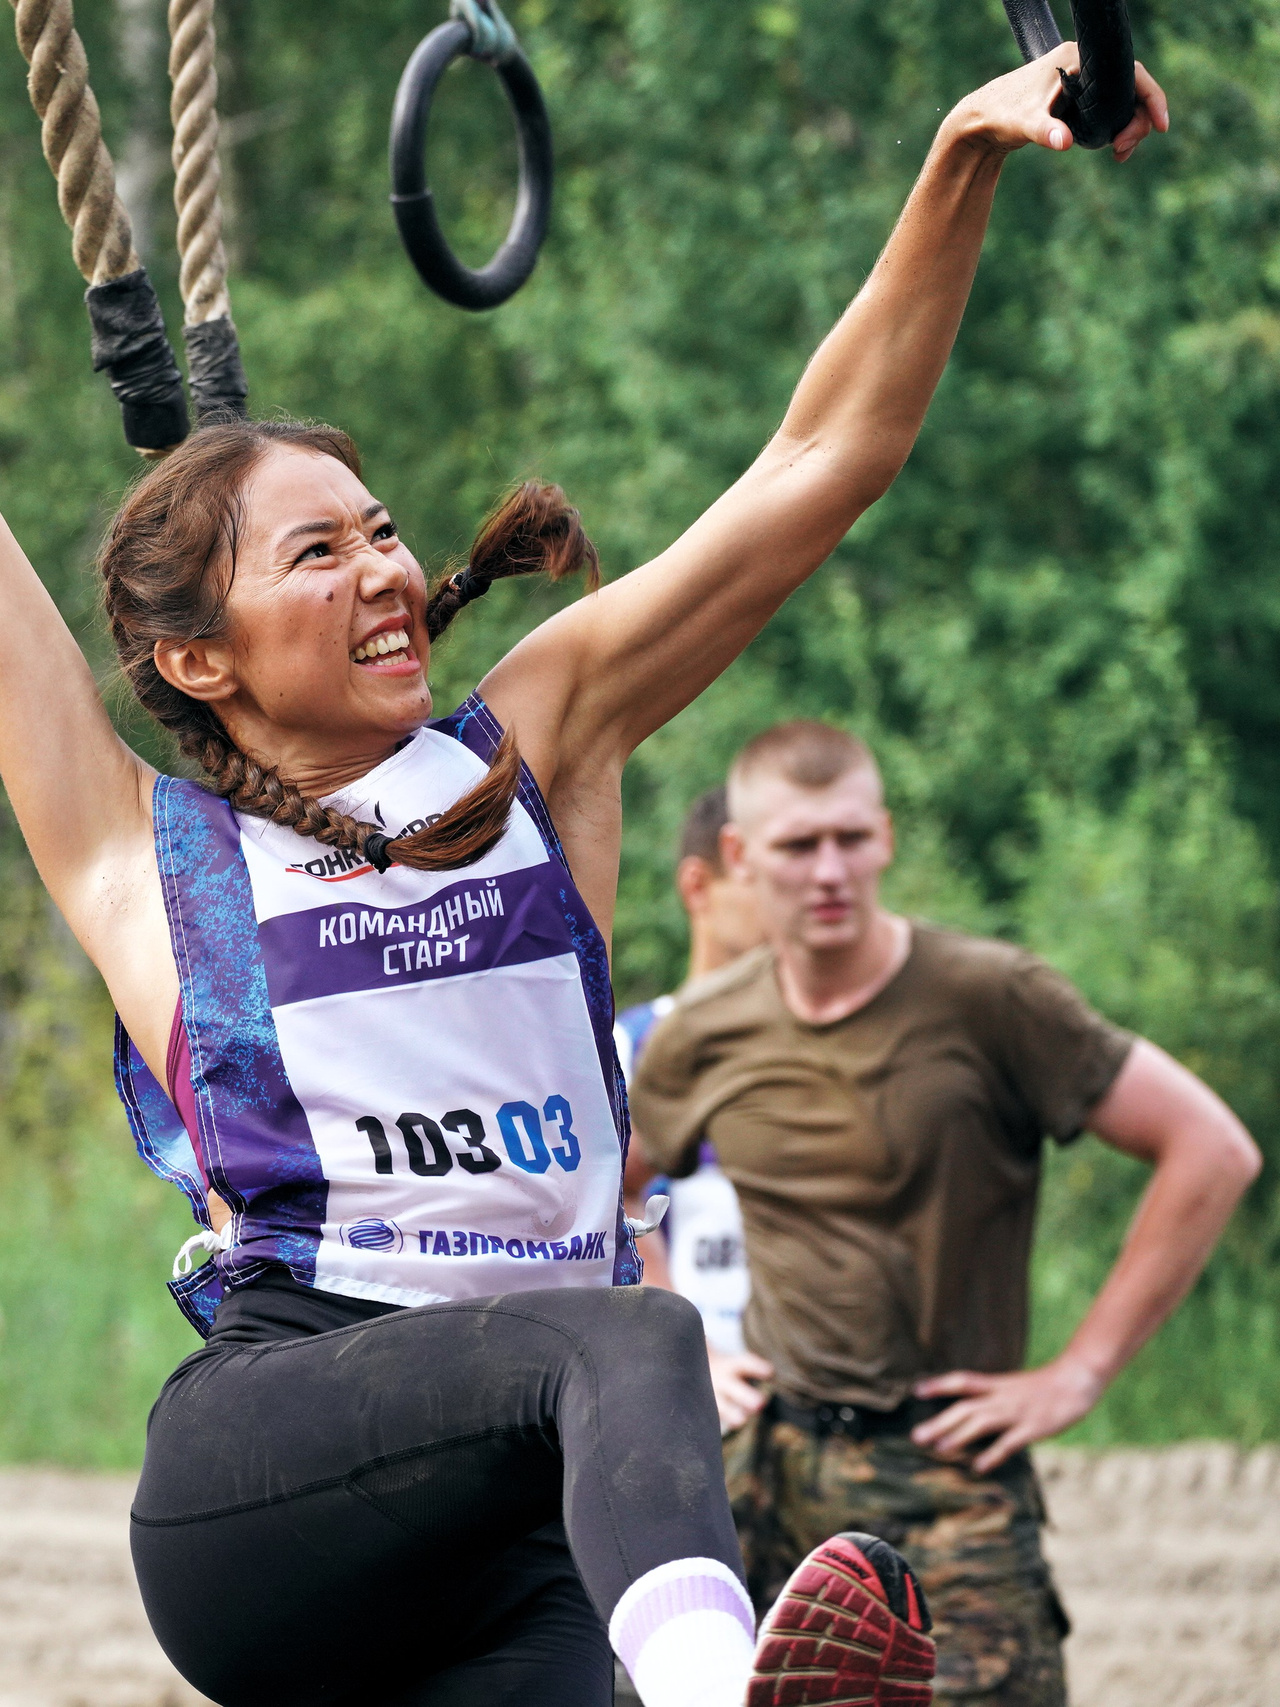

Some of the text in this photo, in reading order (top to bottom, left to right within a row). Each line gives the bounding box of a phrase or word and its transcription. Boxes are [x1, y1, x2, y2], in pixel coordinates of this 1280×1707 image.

[291, 849, 370, 877] ОНК
[319, 879, 505, 947] КОМАНДНЫЙ
[383, 934, 470, 976] СТАРТ
[355, 1094, 582, 1176] 10303
[418, 1230, 608, 1261] ГАЗПРОМБАНК
